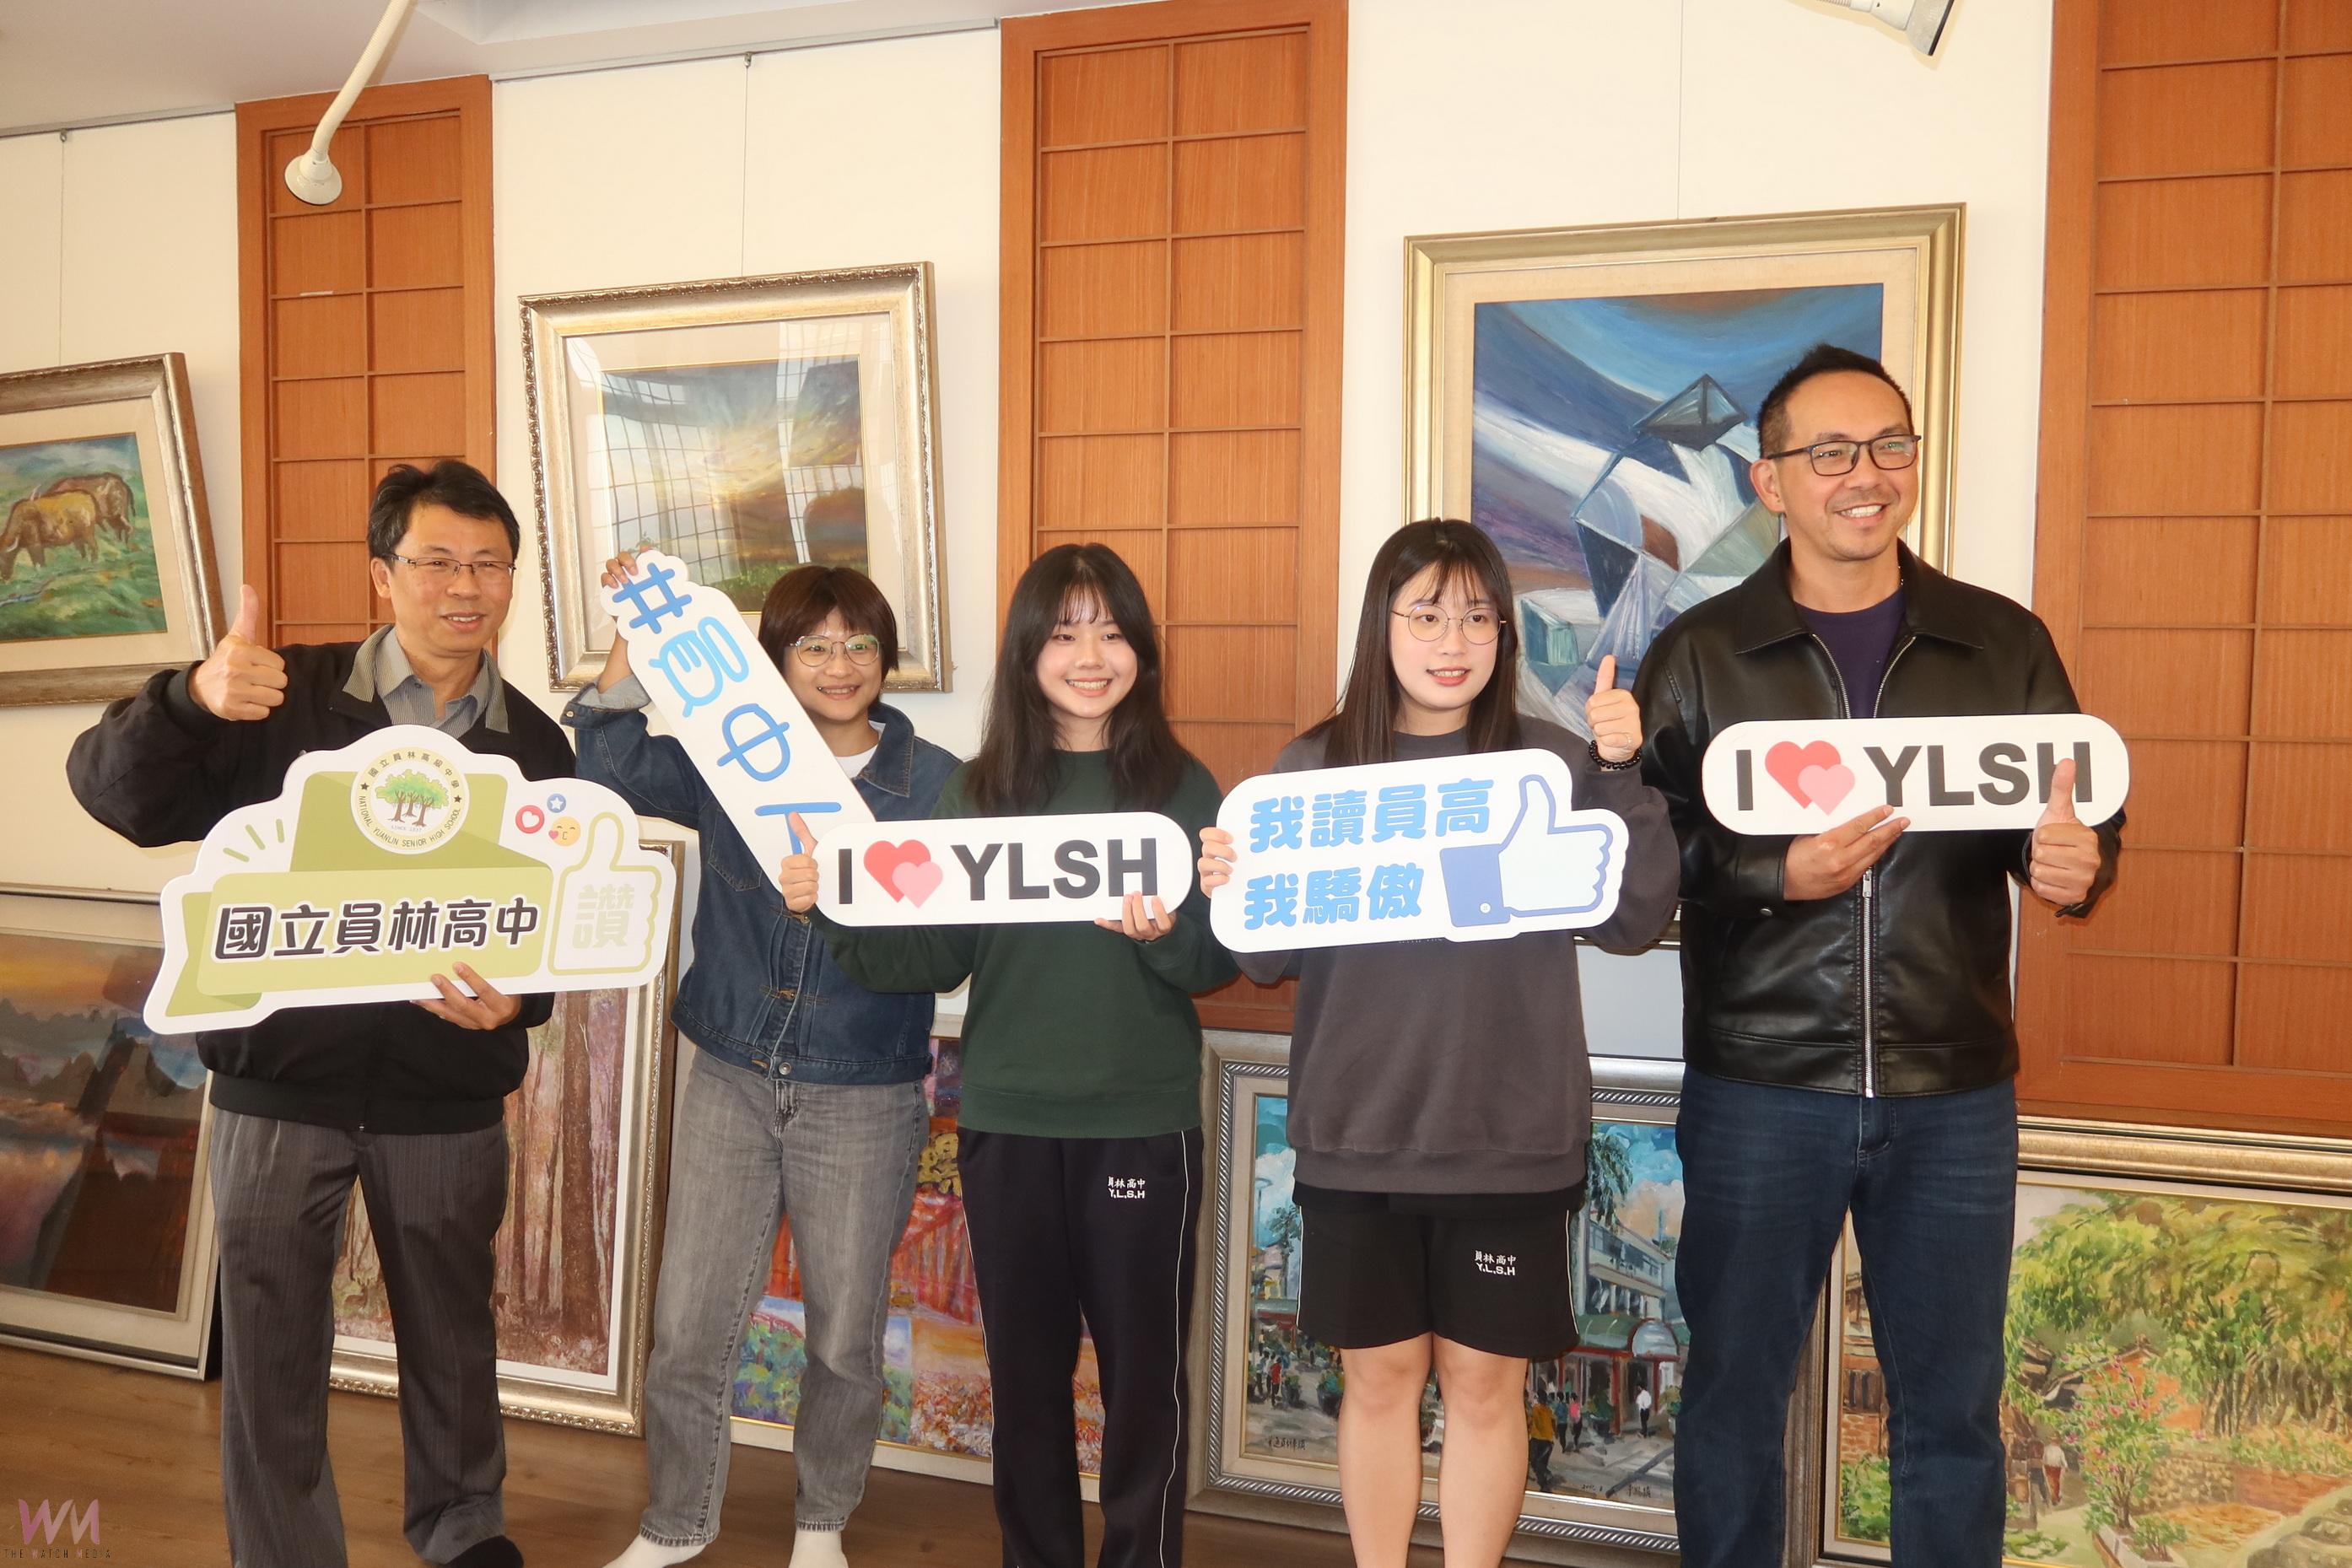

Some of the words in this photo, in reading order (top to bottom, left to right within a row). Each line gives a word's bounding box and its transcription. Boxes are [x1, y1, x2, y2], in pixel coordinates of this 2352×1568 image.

[1735, 749, 1754, 811] I
[1863, 741, 2094, 808] YLSH
[358, 795, 374, 827] NATIONAL
[373, 827, 400, 846] YUANLIN
[402, 838, 428, 848] SENIOR
[429, 829, 445, 843] HIGH
[444, 808, 462, 830] SCHOOL
[1249, 777, 1495, 854] 我讀員高
[838, 849, 853, 905] I
[951, 838, 1158, 902] YLSH
[1244, 862, 1425, 931] 我驕傲
[215, 897, 539, 960] 國立員林高中
[571, 882, 635, 950] 讚
[1475, 1250, 1517, 1266] 員林高中
[1475, 1262, 1516, 1276] Y.L.S.H
